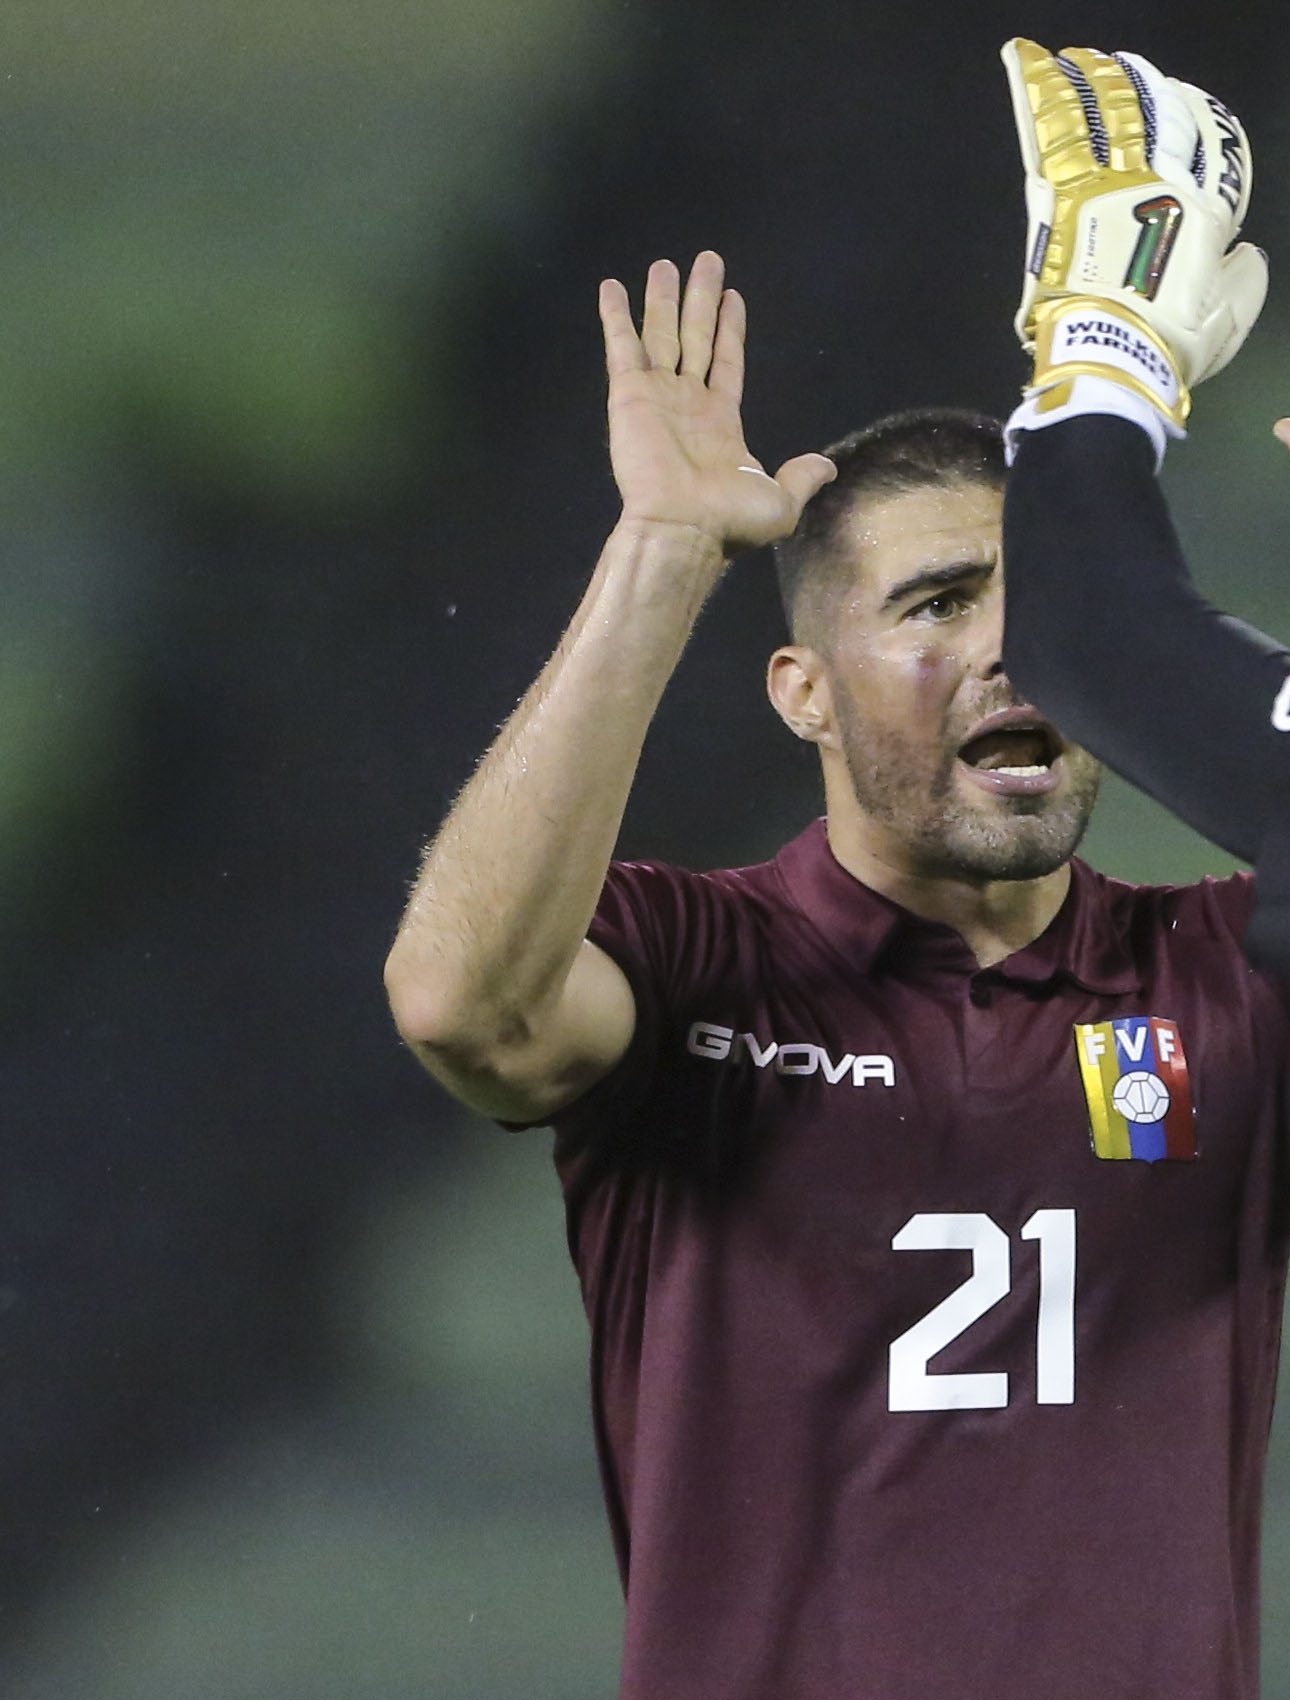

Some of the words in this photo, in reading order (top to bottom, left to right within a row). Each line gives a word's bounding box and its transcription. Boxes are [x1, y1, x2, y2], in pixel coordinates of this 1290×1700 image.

[686, 1021, 896, 1087] GIVOVA
[1084, 1026, 1175, 1066] FVF
[887, 1208, 1076, 1413] 21
